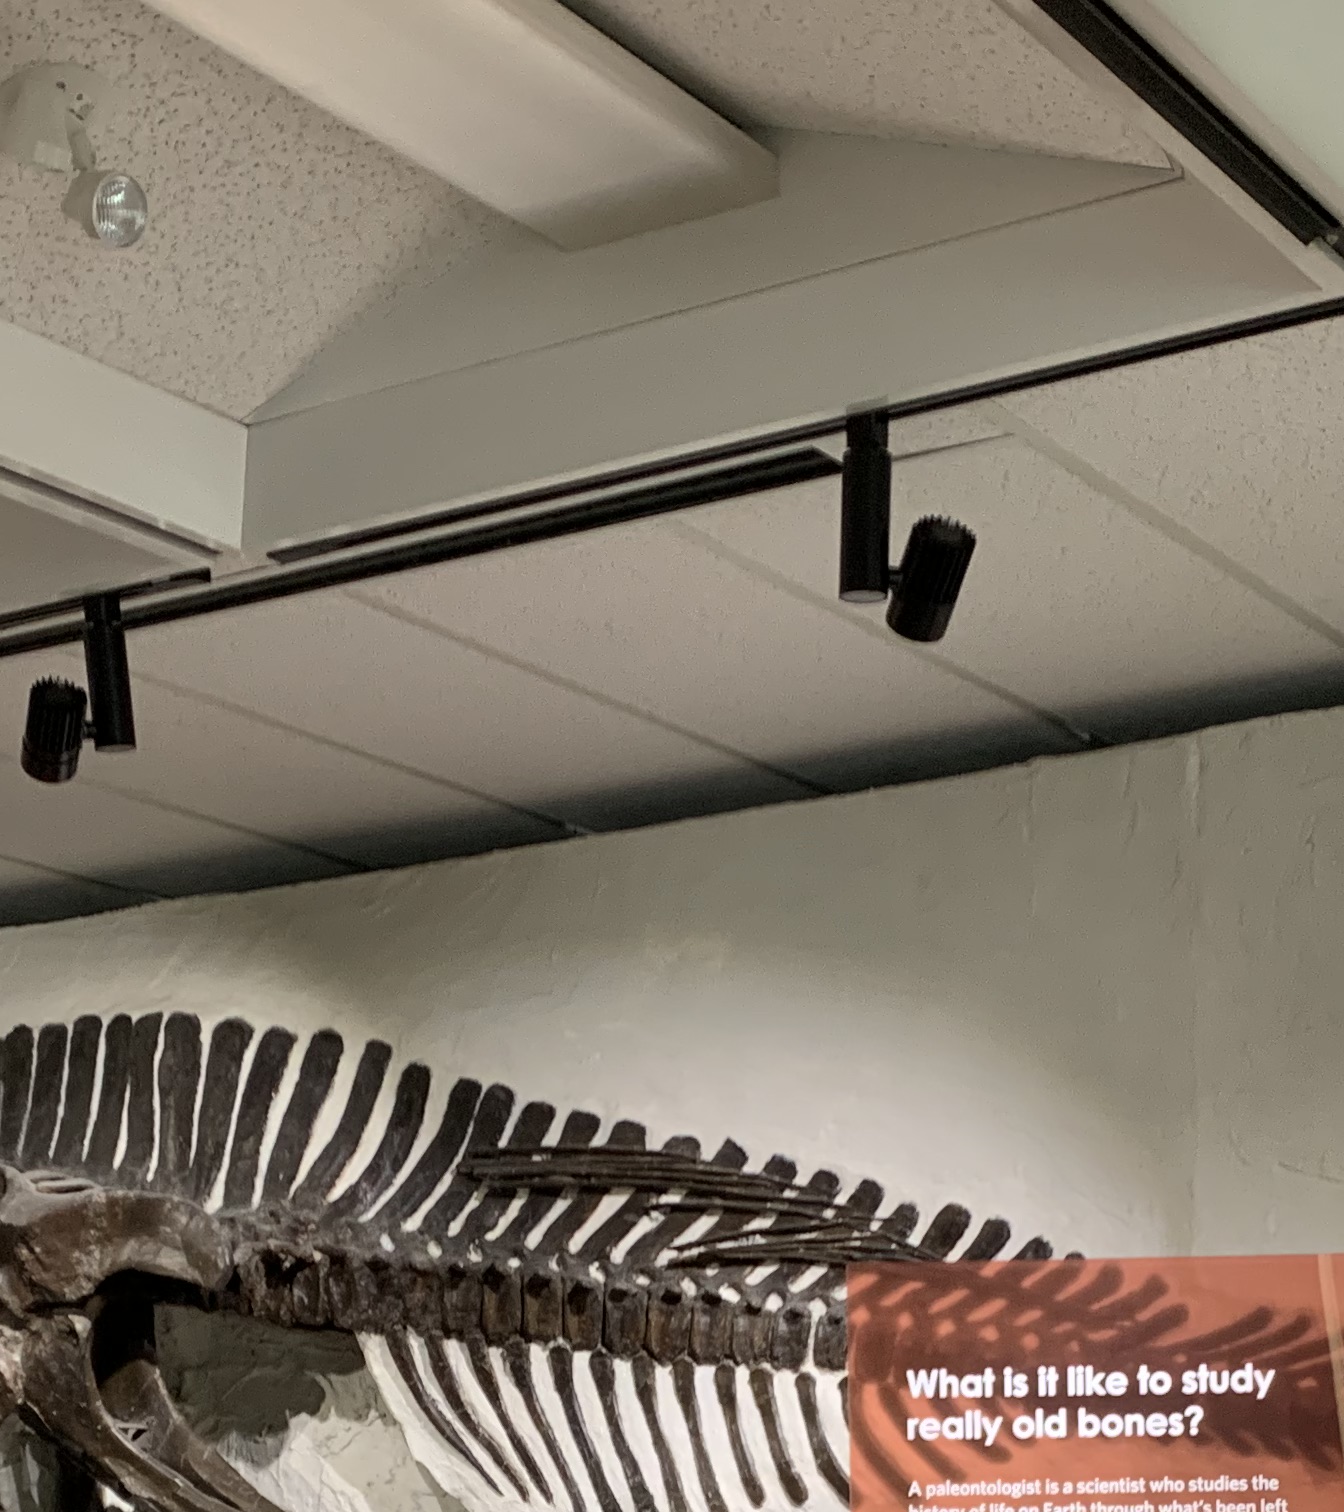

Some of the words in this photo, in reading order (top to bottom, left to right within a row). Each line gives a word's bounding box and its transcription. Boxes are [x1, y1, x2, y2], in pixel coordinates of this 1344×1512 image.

[906, 1366, 996, 1399] What
[1002, 1365, 1029, 1398] is
[1037, 1365, 1059, 1397] it
[1067, 1365, 1128, 1396] like
[1136, 1364, 1172, 1395] to
[1181, 1361, 1276, 1400] study
[906, 1409, 1003, 1446] really
[1012, 1407, 1067, 1439] old
[1077, 1404, 1204, 1438] bones?
[907, 1480, 922, 1497] A
[925, 1478, 1041, 1499] paleontologist
[1045, 1478, 1060, 1495] is
[1062, 1481, 1073, 1494] a
[1076, 1477, 1146, 1494] scientist
[1149, 1475, 1185, 1493] who
[1188, 1475, 1248, 1492] studies
[1250, 1474, 1279, 1491] the
